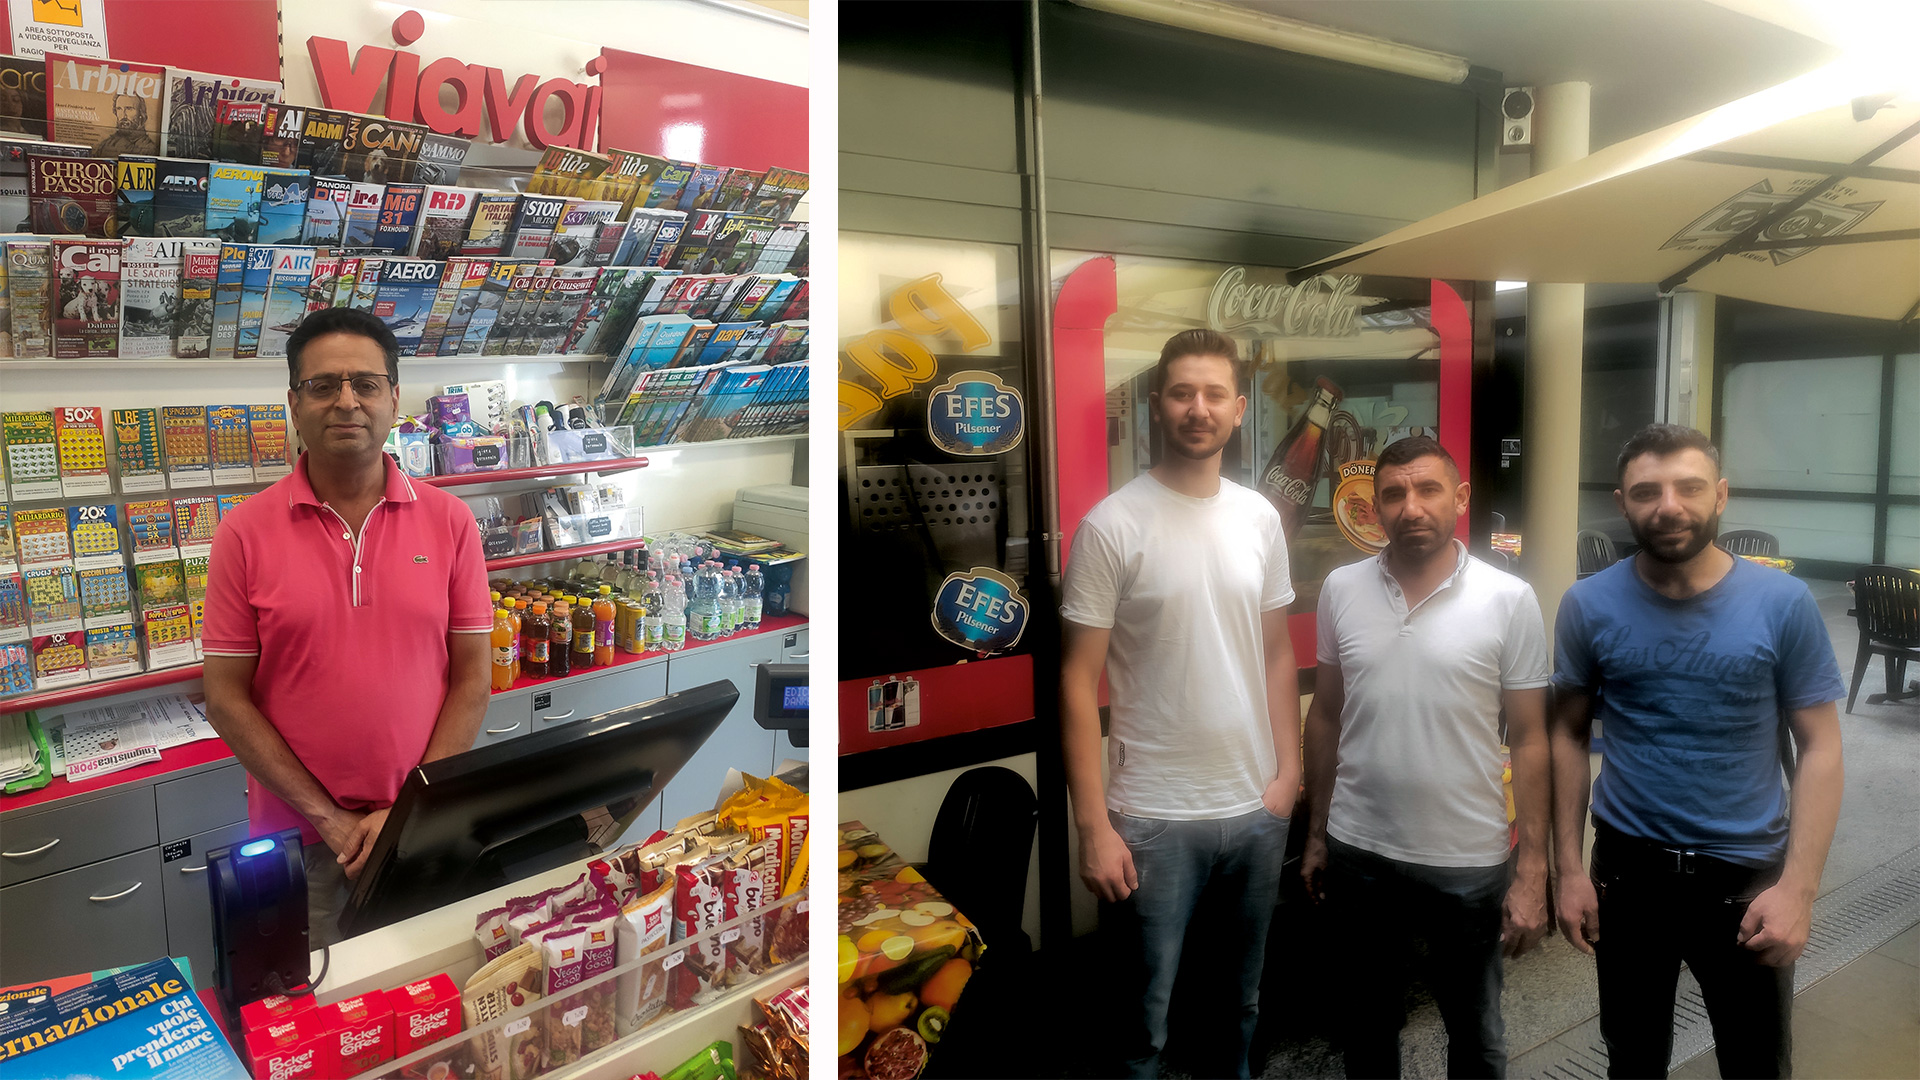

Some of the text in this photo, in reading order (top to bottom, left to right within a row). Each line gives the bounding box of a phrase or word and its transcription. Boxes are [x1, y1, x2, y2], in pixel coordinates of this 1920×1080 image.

[24, 26, 94, 40] AREA SOTTOPOSTA
[25, 33, 101, 48] VIDEOSORVEGLIANZA
[53, 43, 69, 51] PER
[41, 160, 118, 180] CHRON
[42, 176, 116, 195] PASSIO
[381, 210, 403, 225] 31
[564, 213, 587, 226] SKY
[277, 255, 313, 270] AIR
[127, 268, 140, 278] LE
[388, 262, 437, 280] AERO
[249, 403, 284, 413] TURBO CASH
[945, 393, 1012, 419] EFES
[113, 409, 140, 425] IL RE
[954, 421, 1002, 435] Pilsener
[1342, 462, 1377, 479] DÖNER
[151, 500, 168, 508] CASH
[174, 497, 215, 506] NUMERISSIMI
[17, 511, 63, 522] MILIARDARIO
[78, 506, 108, 520] 20X
[147, 531, 160, 540] 5X
[138, 560, 180, 571] ELDORADO
[954, 582, 1020, 624] EFES
[955, 610, 1000, 636] Pilsener
[1591, 624, 1650, 674] Los
[583, 947, 614, 961] VEGGY
[552, 963, 582, 979] VEGGY
[584, 955, 613, 971] GOOD
[553, 972, 582, 989] GOOD
[160, 995, 194, 1016] Chi
[146, 1007, 200, 1037] vuole
[409, 1007, 451, 1028] Pocket
[339, 1025, 383, 1046] Pocket
[409, 1018, 448, 1038] Coffee
[111, 1016, 208, 1072] prendersi
[146, 1050, 164, 1069] il
[161, 1030, 214, 1062] mare
[340, 1035, 381, 1056] Coffee
[269, 1049, 315, 1073] Pocket
[270, 1060, 313, 1080] Coffee
